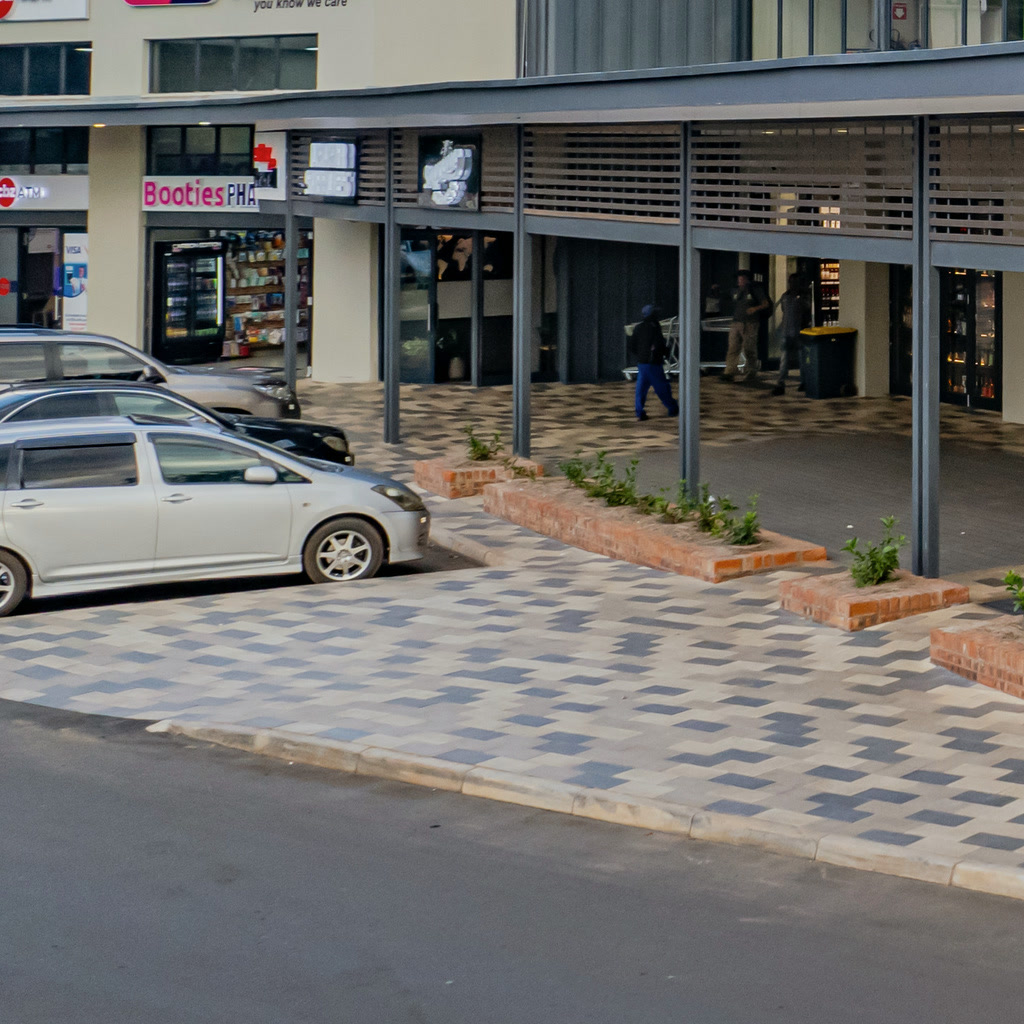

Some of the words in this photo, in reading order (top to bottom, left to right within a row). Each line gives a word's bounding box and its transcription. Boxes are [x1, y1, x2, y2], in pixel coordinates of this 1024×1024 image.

[254, 0, 274, 13] you
[18, 186, 45, 198] ATM
[143, 179, 224, 207] Booties
[66, 246, 81, 254] VISA
